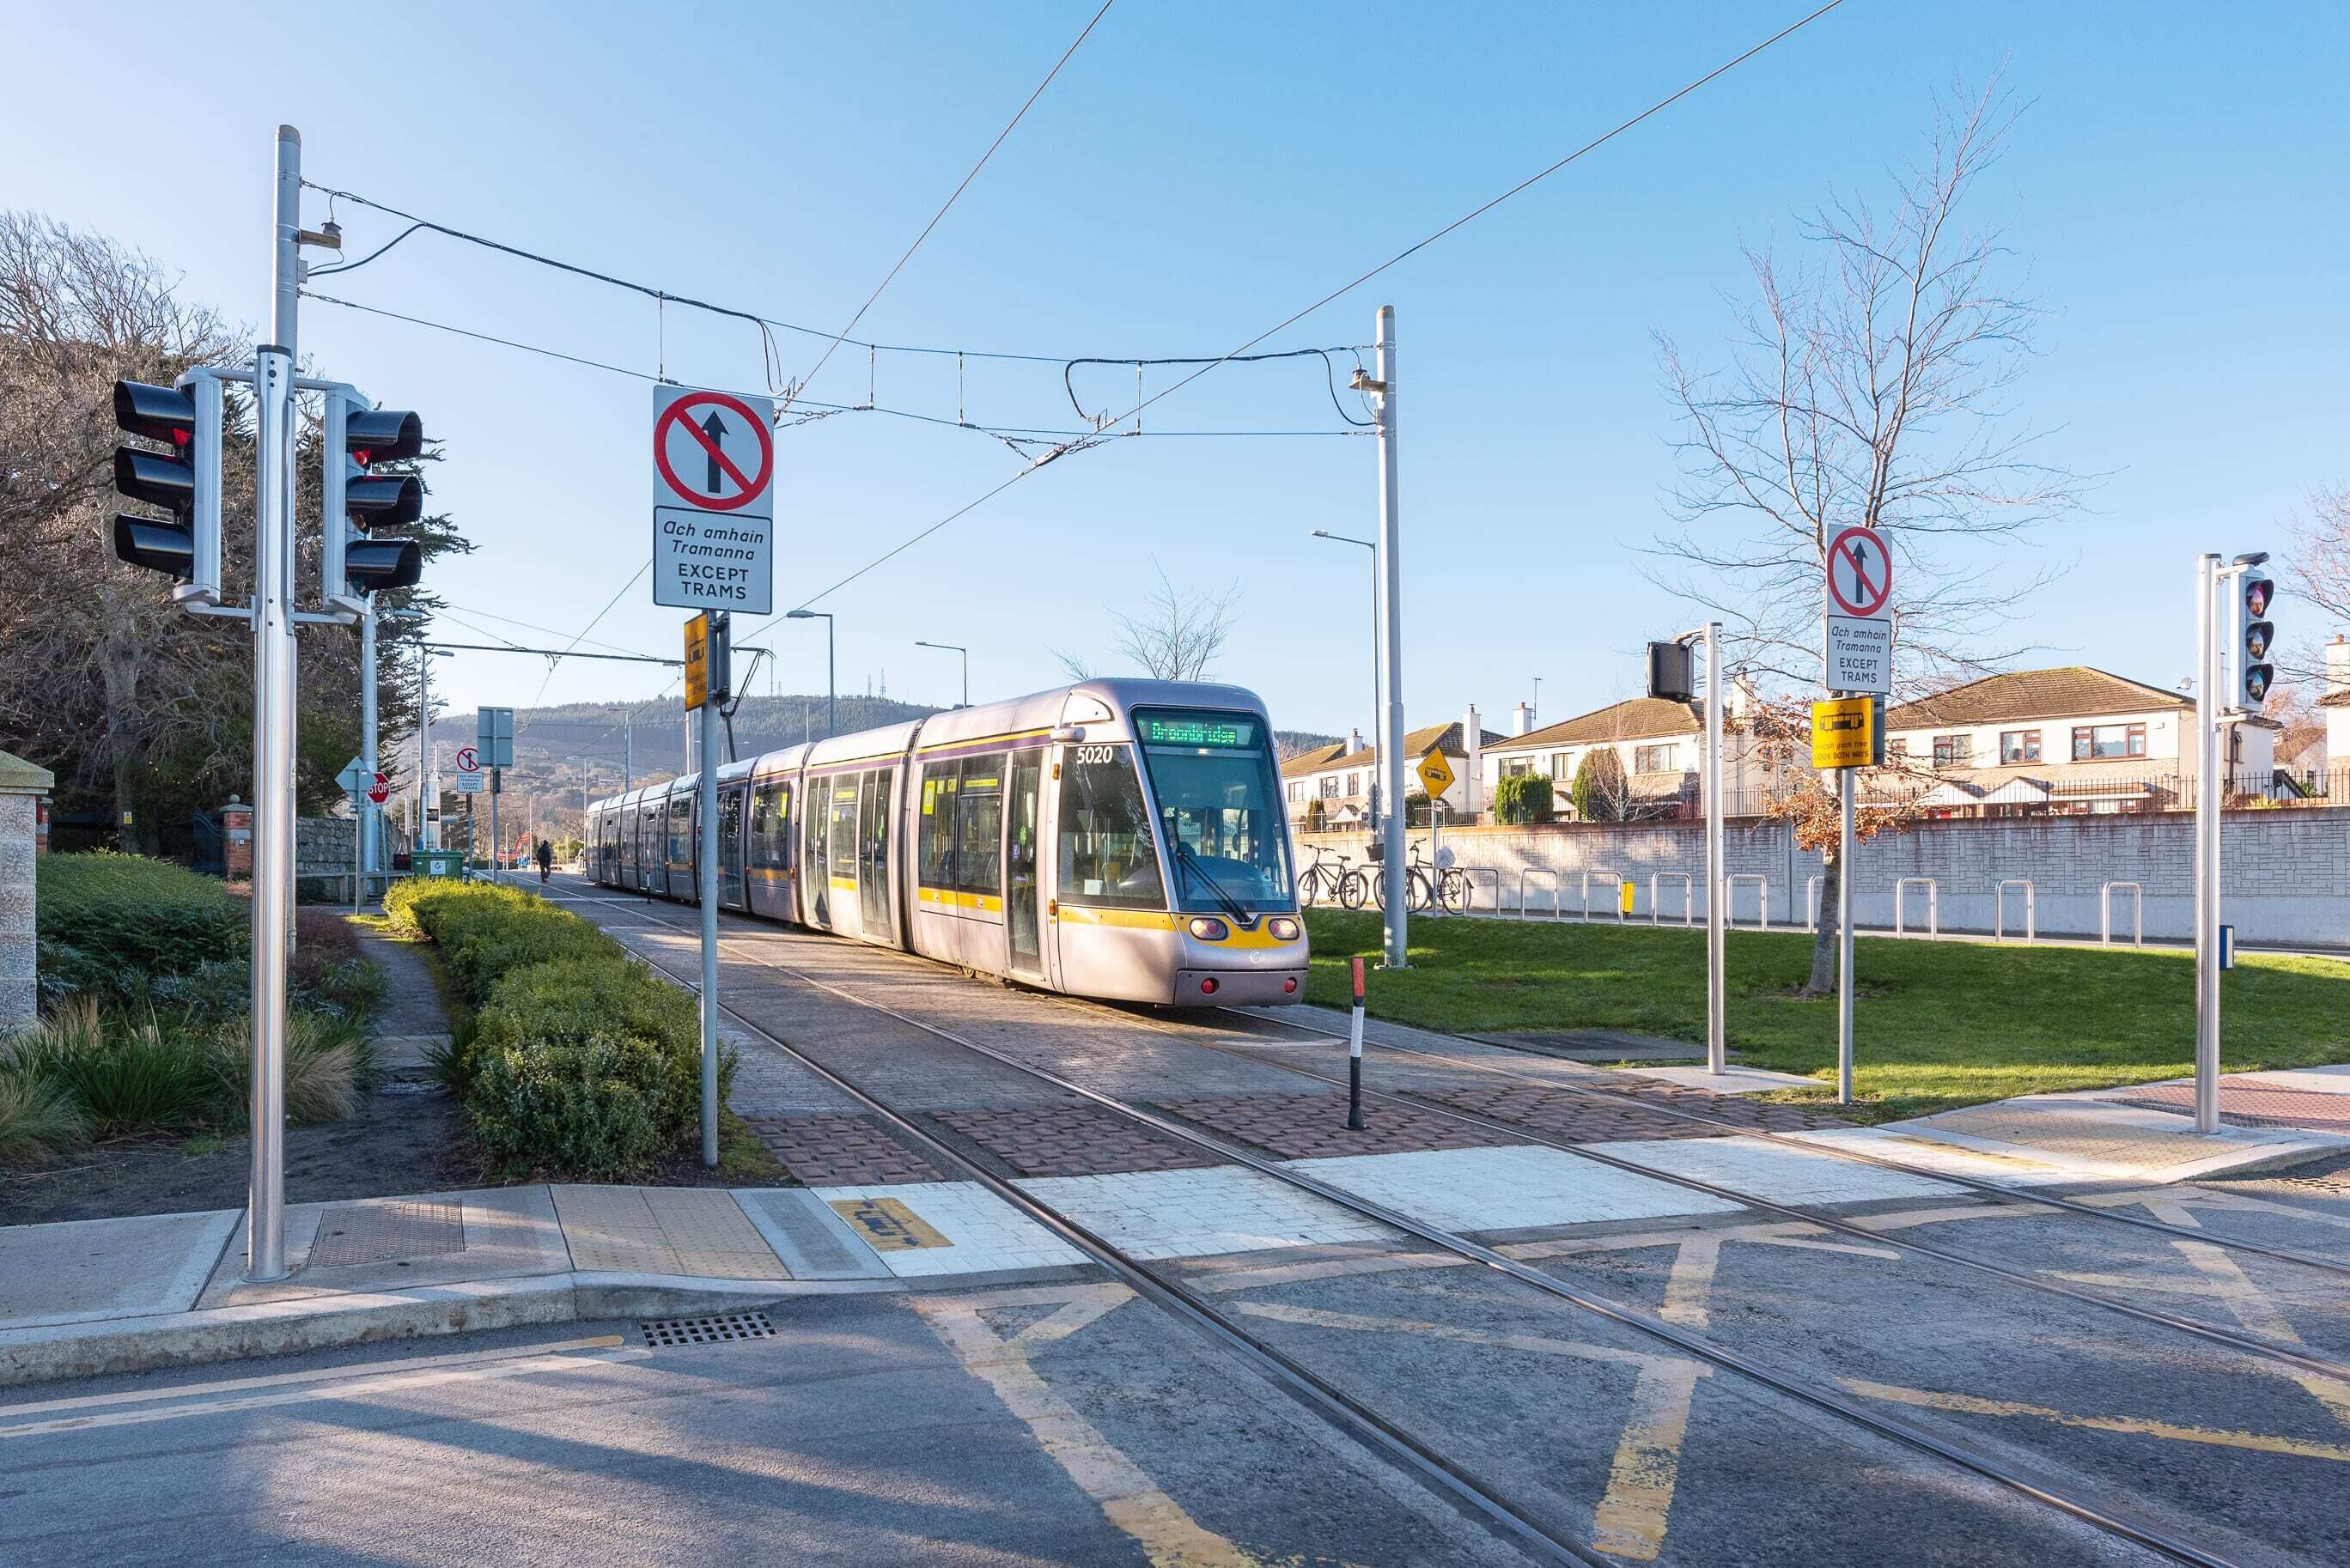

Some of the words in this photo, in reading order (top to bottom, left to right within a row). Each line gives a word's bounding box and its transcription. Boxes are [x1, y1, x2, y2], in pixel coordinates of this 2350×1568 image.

[673, 539, 755, 561] Tramanna
[679, 562, 749, 582] EXCEPT
[681, 581, 746, 599] TRAMS
[1836, 640, 1882, 653] Tramanna
[1840, 657, 1878, 670] EXCEPT
[1841, 671, 1877, 684] TRAMS
[1076, 745, 1113, 764] 5020
[1813, 752, 1831, 761] OOK
[1833, 751, 1850, 760] BOTH
[1852, 750, 1869, 758] WAYS
